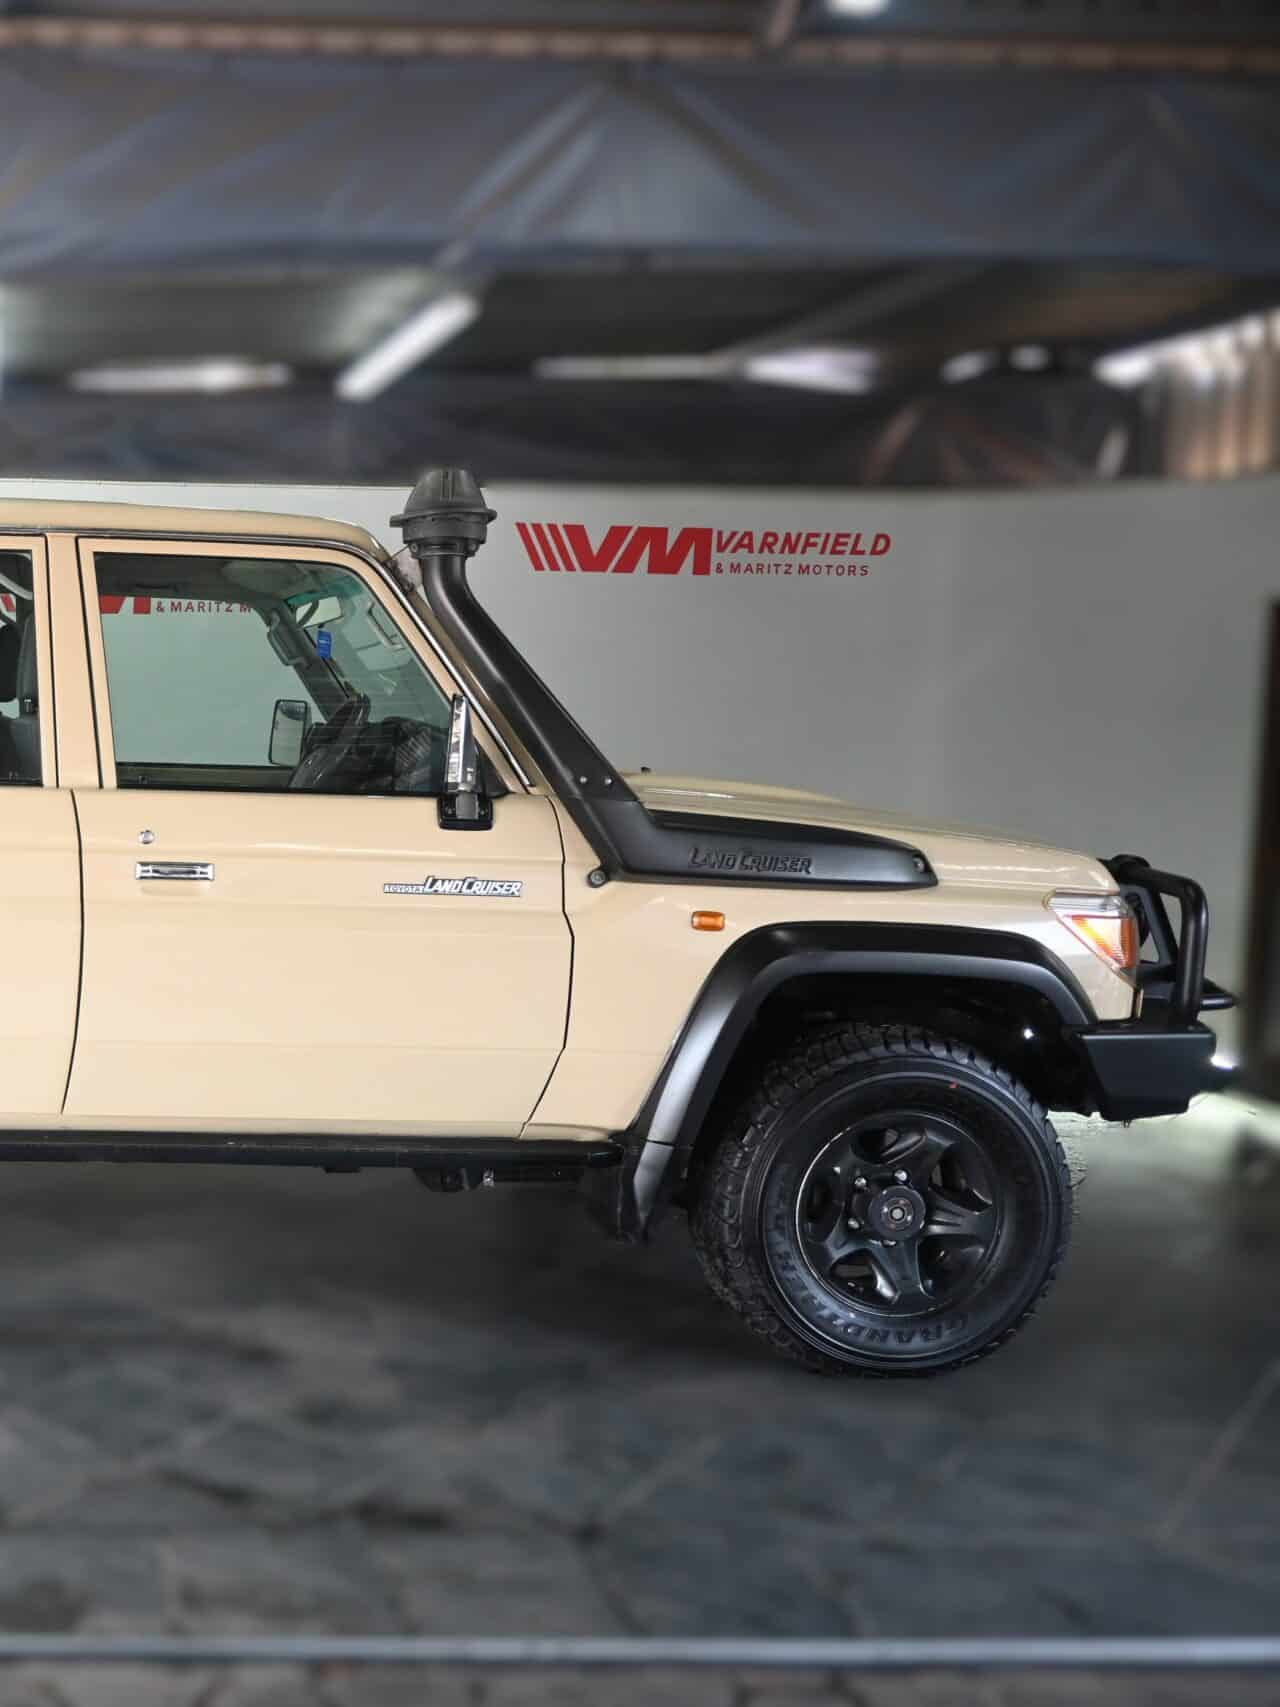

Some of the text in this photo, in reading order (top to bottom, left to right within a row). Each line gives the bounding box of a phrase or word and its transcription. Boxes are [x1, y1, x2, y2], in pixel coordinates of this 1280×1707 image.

[716, 529, 891, 557] VARNFIELD
[715, 561, 870, 577] & MARITZ MOTORS
[170, 601, 234, 614] MARITZ
